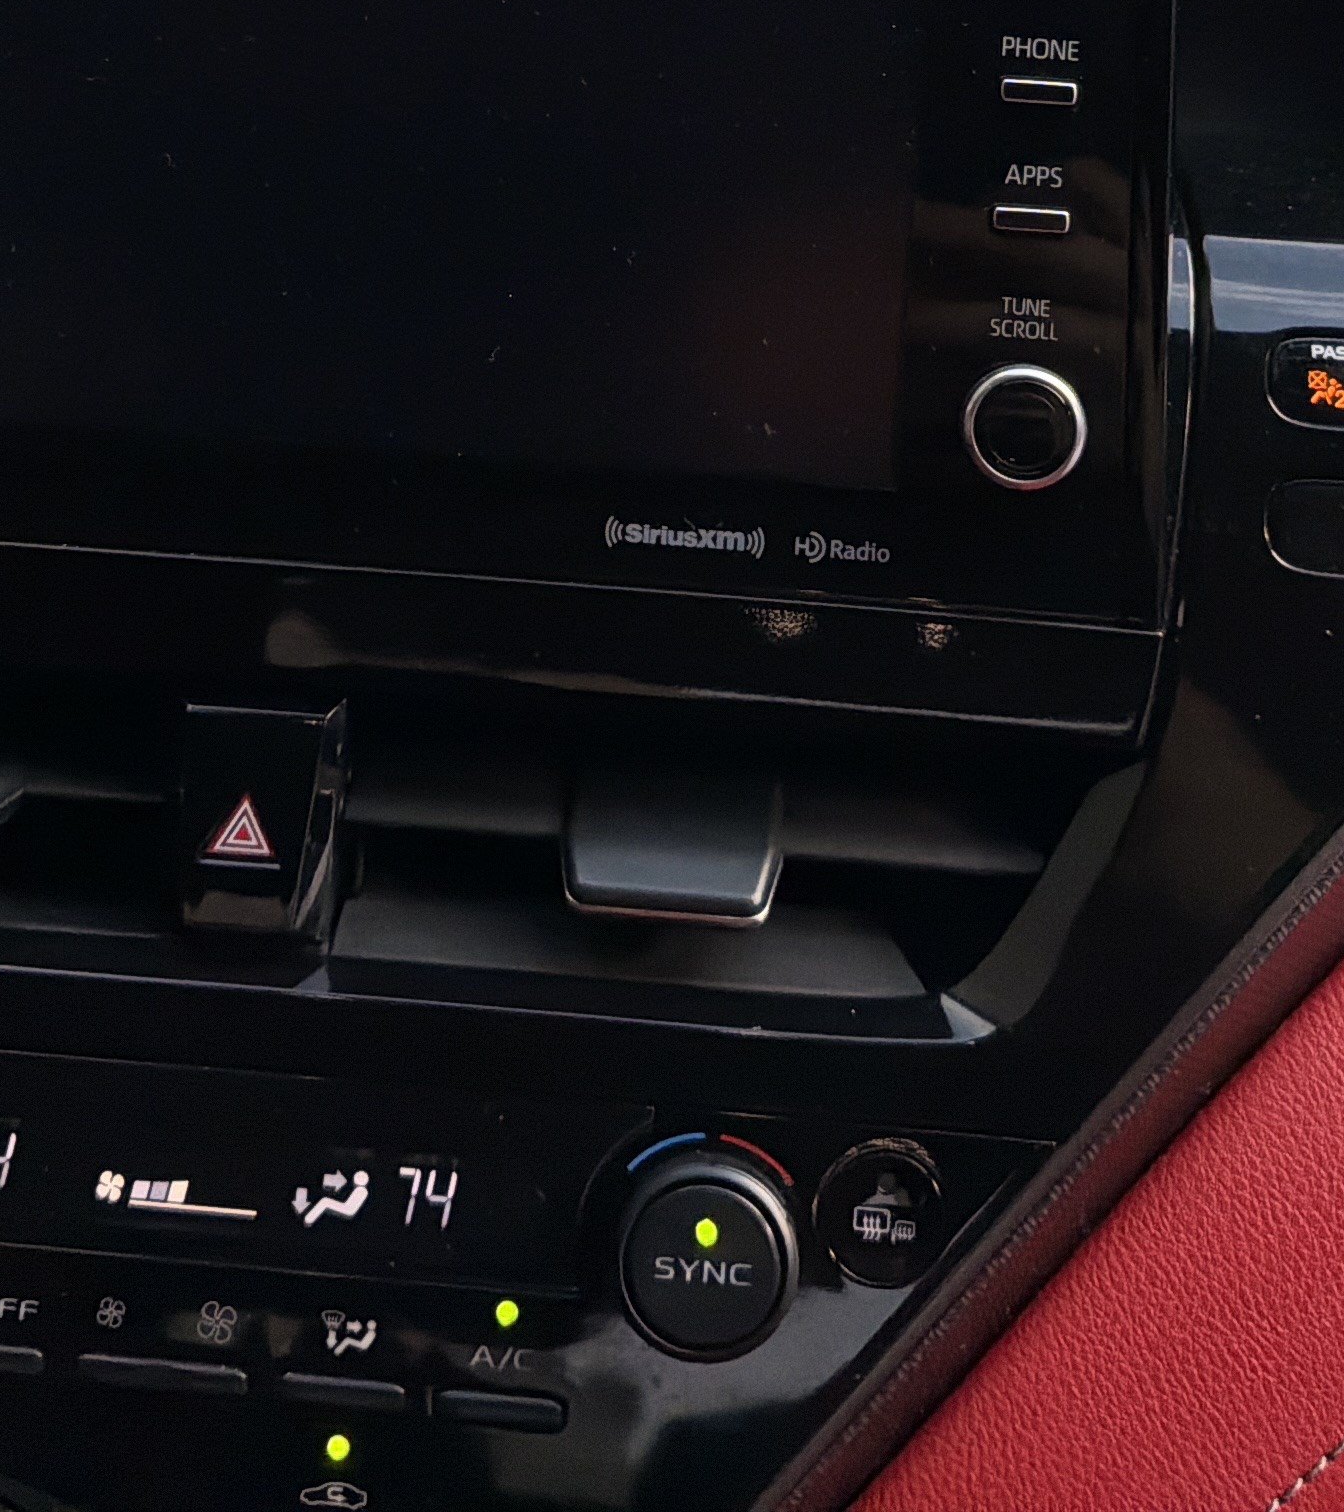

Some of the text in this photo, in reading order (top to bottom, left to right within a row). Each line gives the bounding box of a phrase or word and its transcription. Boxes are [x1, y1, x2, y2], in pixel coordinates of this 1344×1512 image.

[1001, 36, 1080, 62] PHONE
[1004, 164, 1063, 188] APPS
[1002, 296, 1051, 318] TUNE
[990, 318, 1059, 342] SCROLL
[829, 540, 891, 564] Radio
[399, 1167, 457, 1229] 74
[654, 1256, 753, 1287] SYNC
[469, 1345, 532, 1371] A/C
